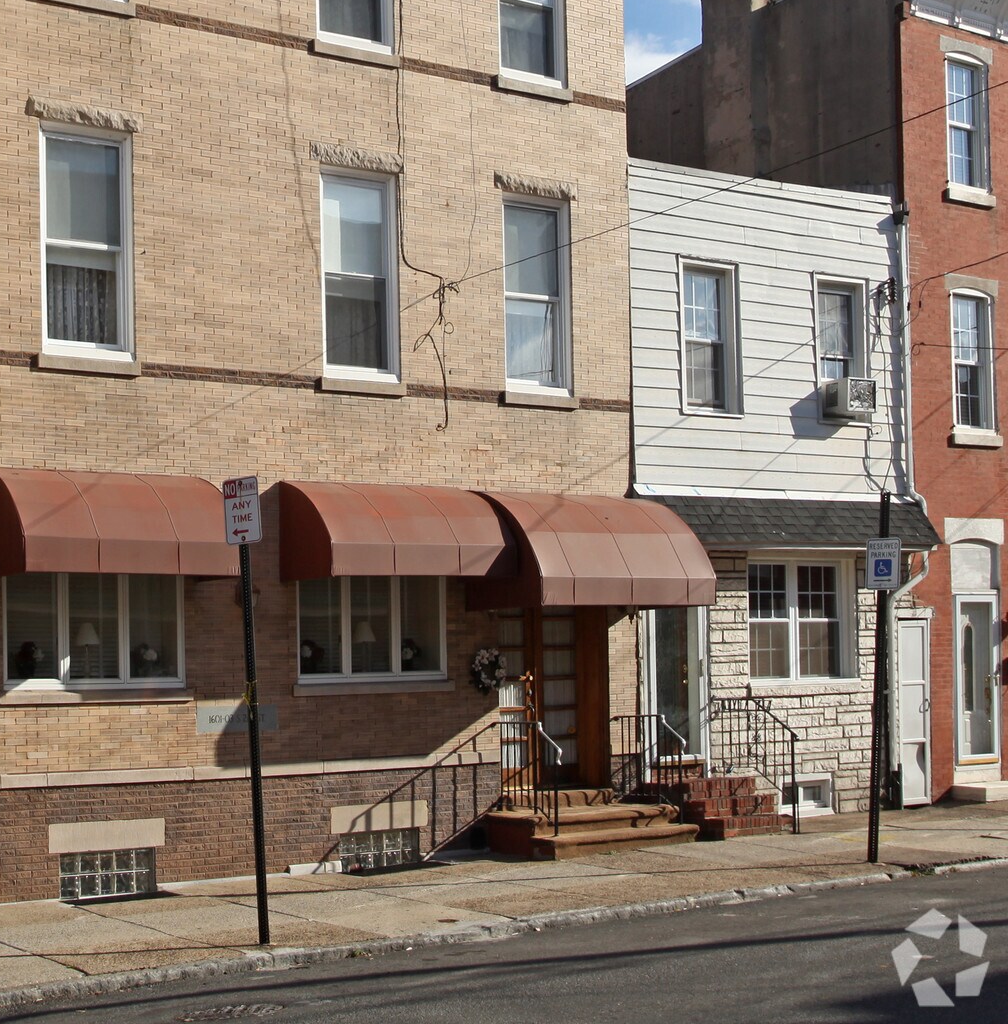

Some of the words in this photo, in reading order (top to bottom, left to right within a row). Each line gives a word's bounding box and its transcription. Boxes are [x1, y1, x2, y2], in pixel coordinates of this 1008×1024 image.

[224, 483, 236, 497] NO
[232, 499, 252, 511] ANY
[232, 513, 253, 524] TIME
[869, 542, 899, 550] RESERVED
[870, 550, 897, 559] PARKING
